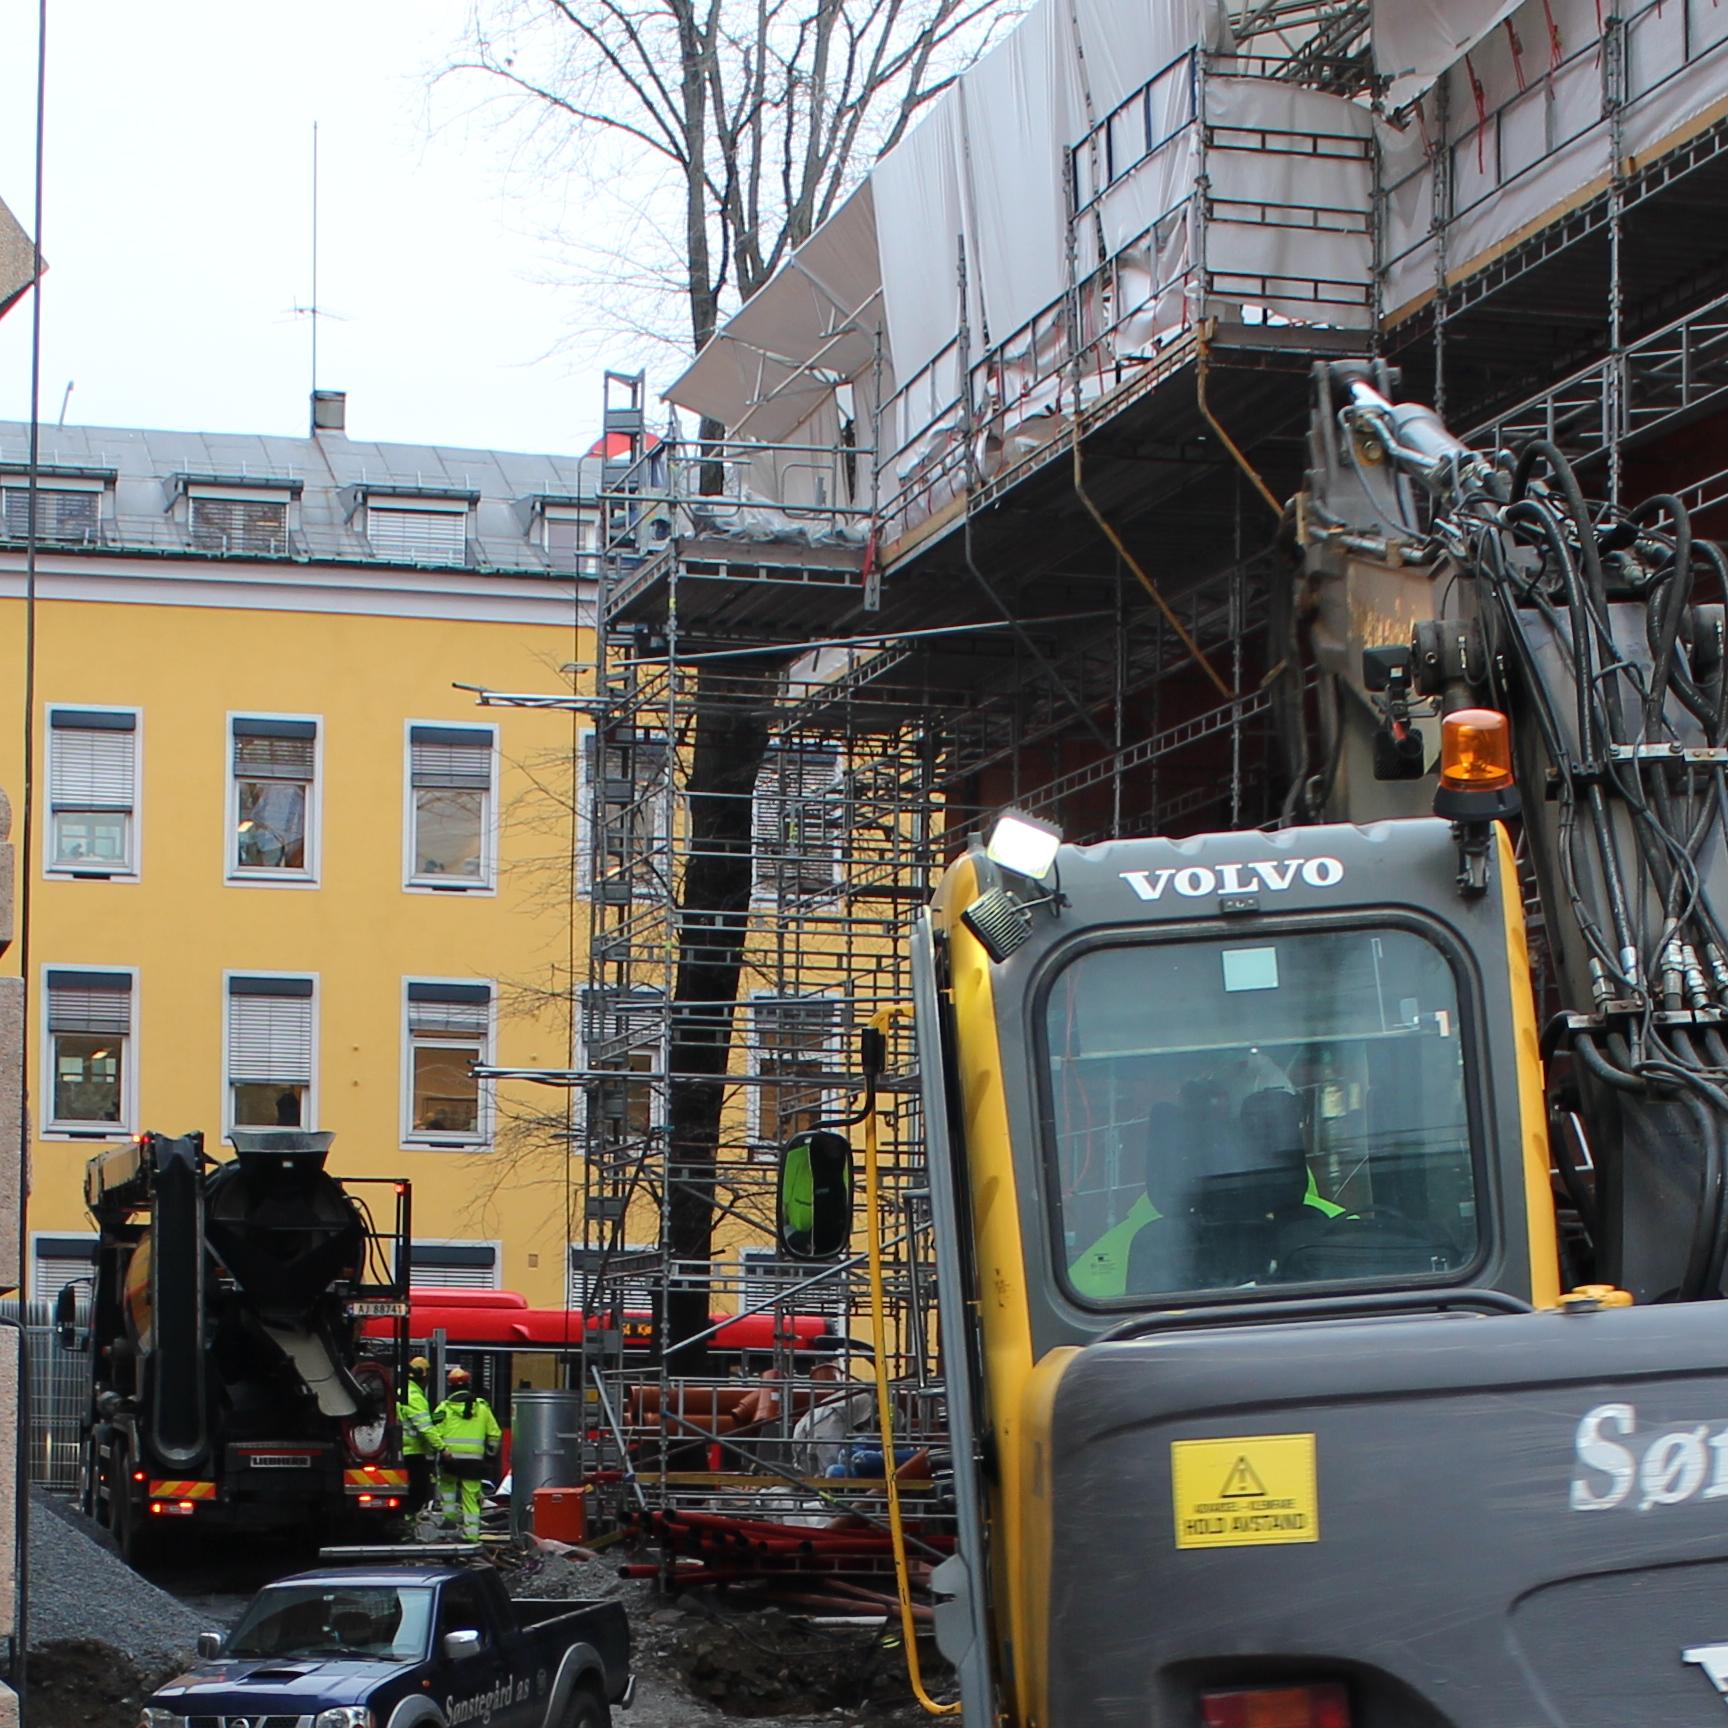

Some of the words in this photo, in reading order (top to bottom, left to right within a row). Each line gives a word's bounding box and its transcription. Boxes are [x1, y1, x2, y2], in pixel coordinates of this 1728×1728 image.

[1119, 856, 1345, 902] VOLVO
[1184, 1517, 1227, 1536] HOLD
[1231, 1513, 1306, 1533] AVSTAND
[445, 1673, 513, 1728] Sønstegård
[515, 1678, 530, 1702] as
